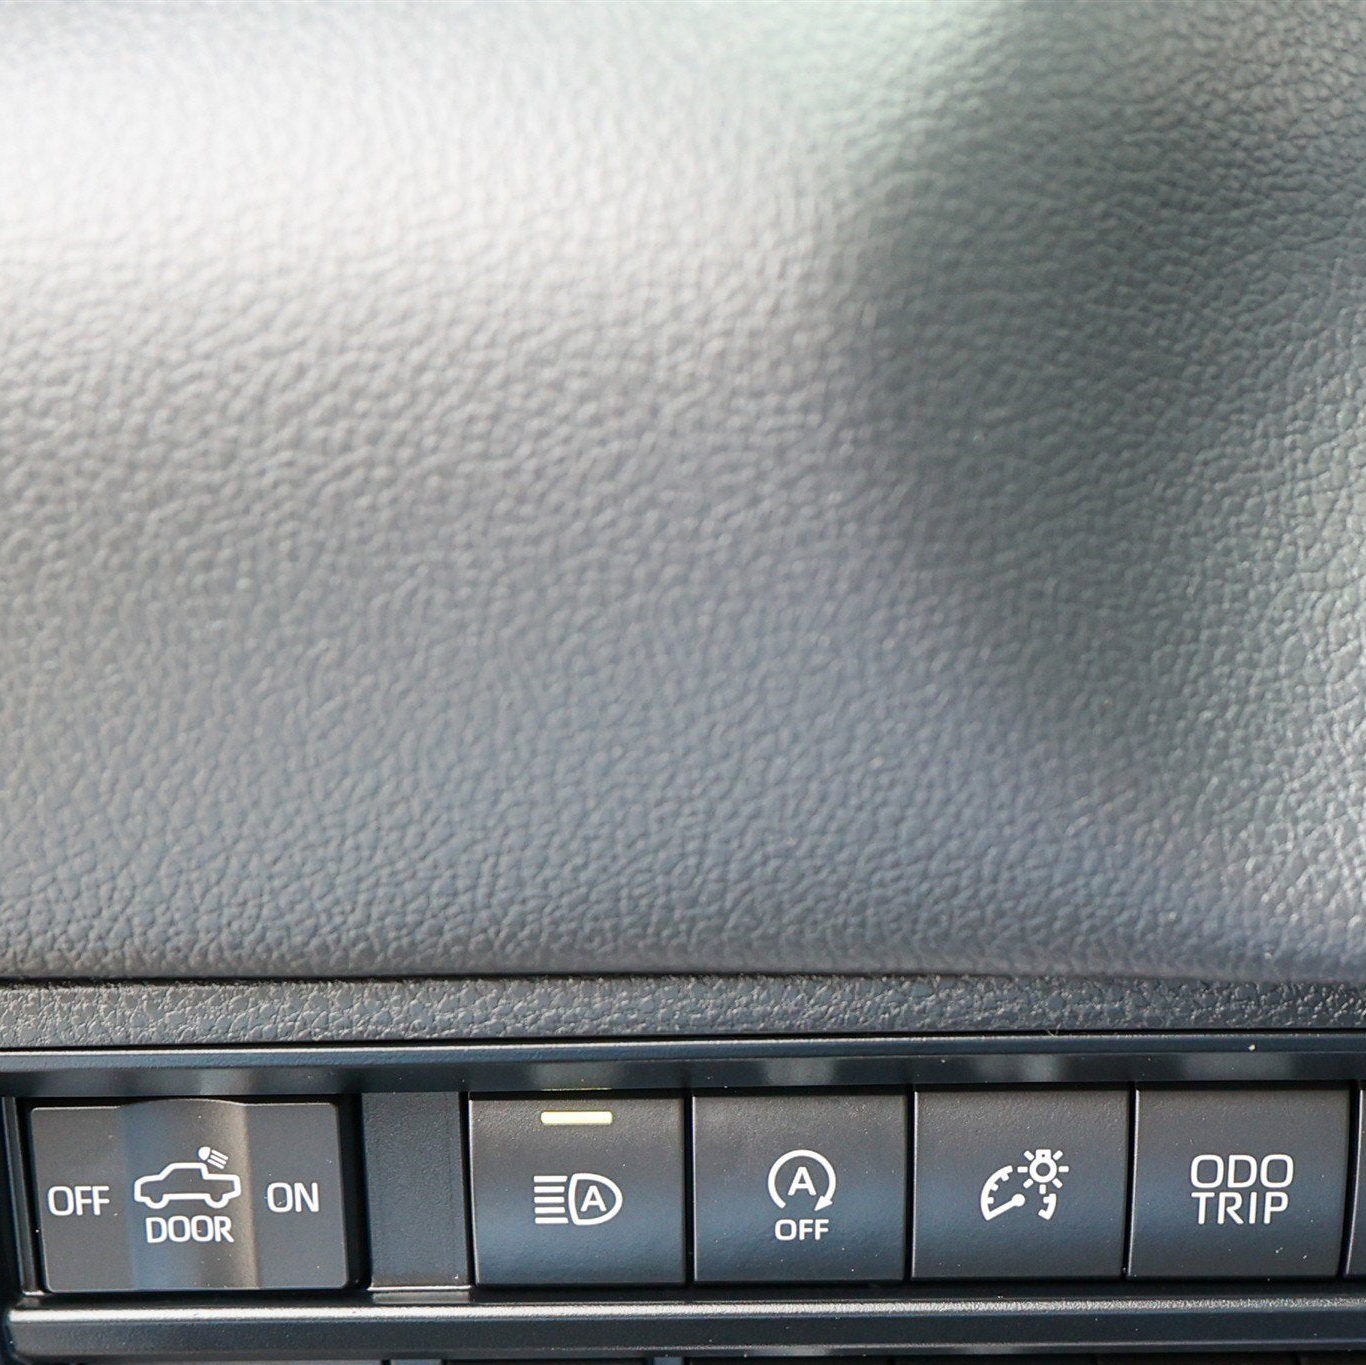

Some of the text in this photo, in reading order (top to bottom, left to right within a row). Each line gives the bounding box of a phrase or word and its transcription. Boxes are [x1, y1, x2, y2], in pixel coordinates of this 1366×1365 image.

[787, 1165, 818, 1197] A
[1190, 1153, 1294, 1190] ODO
[47, 1185, 110, 1217] OFF
[265, 1181, 320, 1214] ON
[579, 1184, 608, 1213] A
[1190, 1190, 1289, 1225] TRIP
[145, 1215, 235, 1244] DOOR
[774, 1218, 830, 1242] OFF
